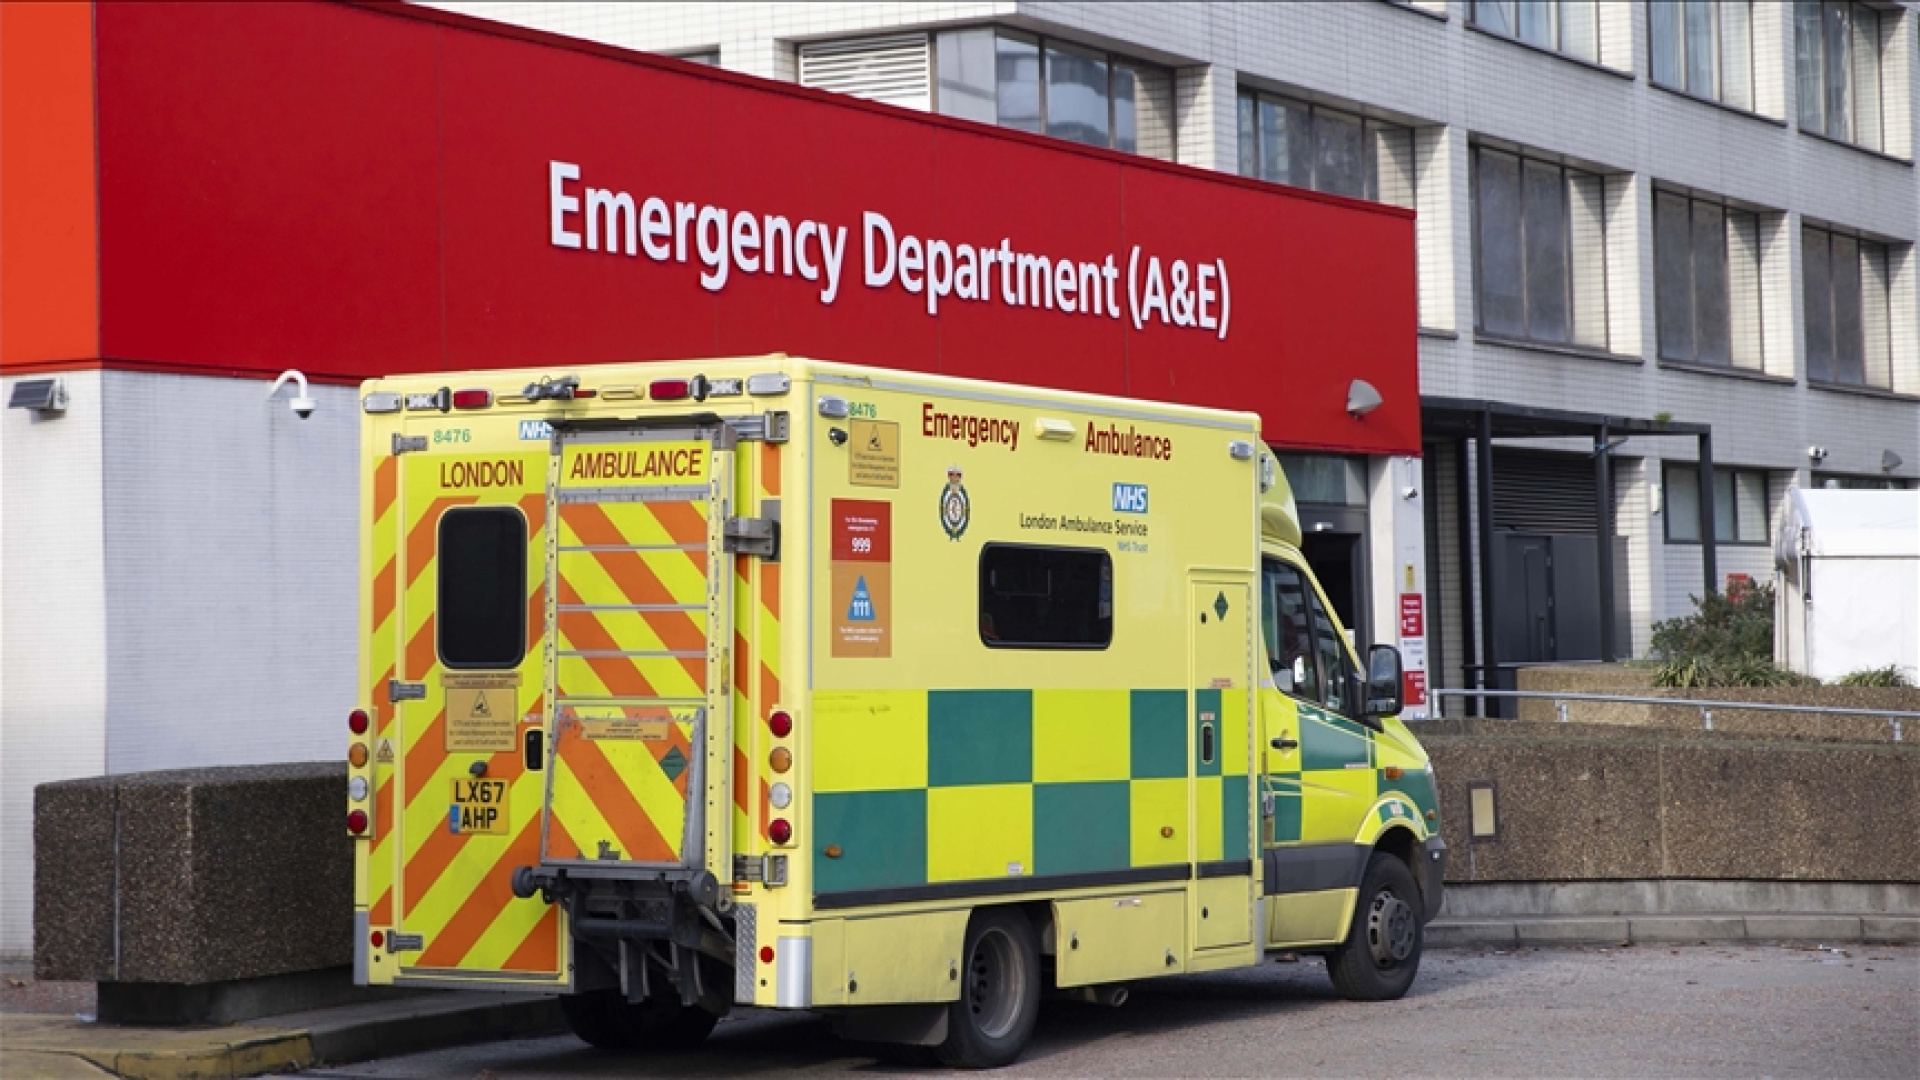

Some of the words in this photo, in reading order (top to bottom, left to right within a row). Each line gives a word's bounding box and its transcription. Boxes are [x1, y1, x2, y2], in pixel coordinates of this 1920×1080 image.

[550, 160, 848, 304] Emergency
[863, 210, 1120, 316] Department
[1128, 246, 1230, 340] (A&E)
[433, 429, 471, 443] 8476
[922, 403, 1020, 451] Emergency
[1085, 420, 1172, 461] Ambulance
[440, 460, 524, 488] LONDON
[570, 449, 704, 480] AMBULANCE
[1114, 485, 1147, 511] NHS
[1019, 512, 1058, 530] London
[1059, 515, 1113, 534] Ambulance
[1115, 519, 1148, 537] Service
[851, 537, 871, 553] 999
[852, 599, 871, 617] 111
[455, 780, 505, 803] LX67
[462, 806, 498, 830] AHP
